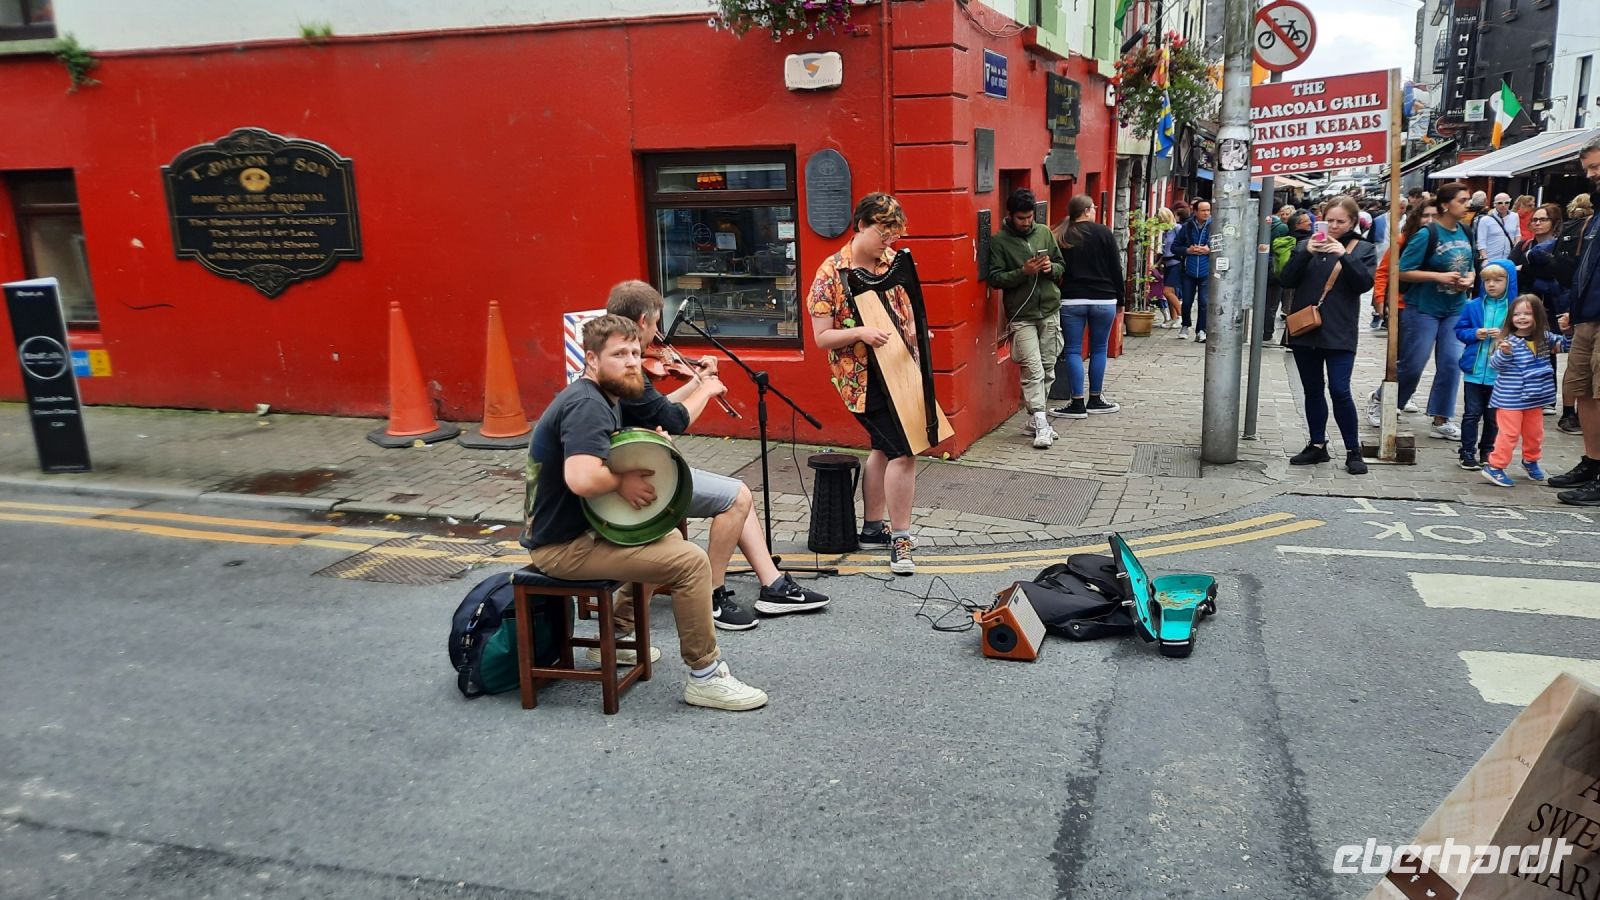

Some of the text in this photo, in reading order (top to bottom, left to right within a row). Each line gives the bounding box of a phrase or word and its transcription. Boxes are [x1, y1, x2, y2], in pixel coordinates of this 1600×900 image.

[1456, 33, 1470, 98] HOTEL
[1291, 81, 1326, 97] THE
[1250, 93, 1381, 120] HARCOAL GRILL
[1252, 114, 1382, 142] RKISH KEBABS
[1255, 139, 1362, 160] Tel: 091 339 343
[294, 157, 331, 178] SON
[1270, 153, 1374, 173] Cross Street
[270, 193, 327, 202] ORIGINAL
[279, 216, 337, 226] Friendship
[1528, 803, 1600, 855] SWE
